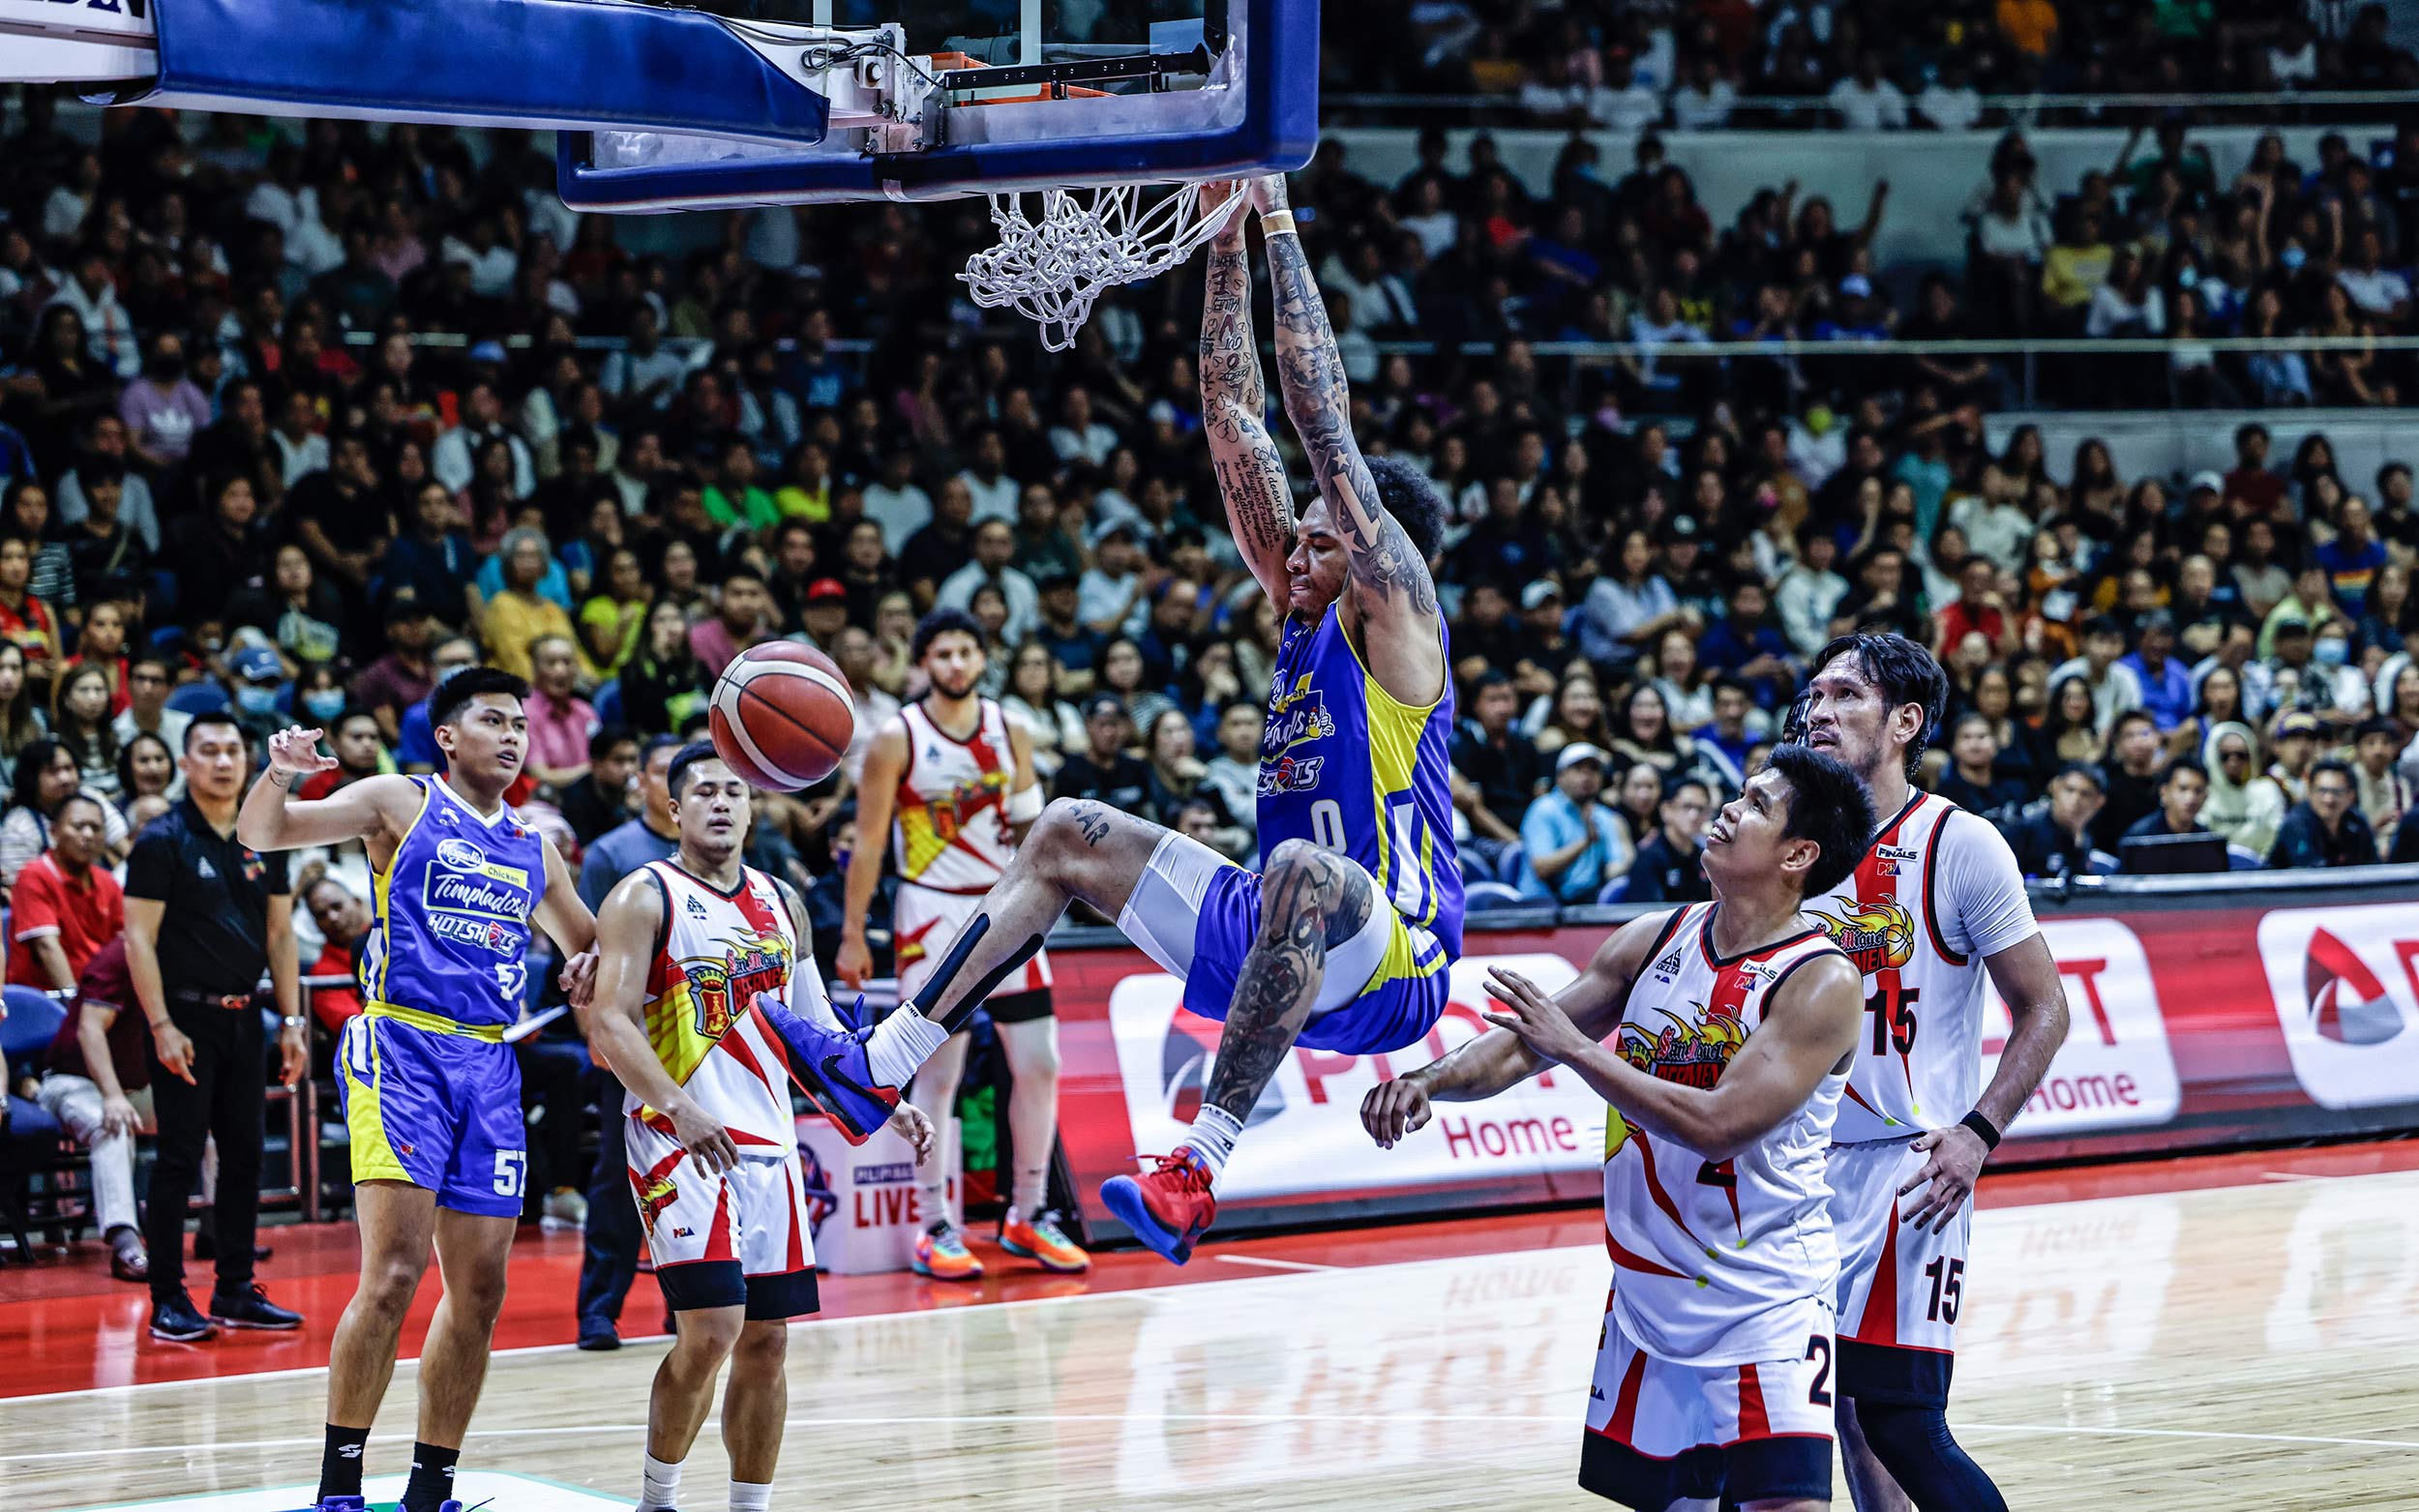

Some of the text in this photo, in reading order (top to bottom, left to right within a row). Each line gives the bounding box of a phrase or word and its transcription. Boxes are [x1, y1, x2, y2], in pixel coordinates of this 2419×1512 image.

[1252, 446, 1274, 475] God
[1268, 476, 1287, 514] doesn't
[1310, 799, 1347, 855] 0
[438, 841, 484, 867] Magnolia
[1877, 862, 1901, 876] PBA
[1878, 847, 1917, 860] FINALS
[488, 866, 520, 884] Chicken
[1840, 926, 1888, 950] Miguel
[1656, 963, 1680, 976] DELTA
[1865, 988, 1920, 1055] 15
[1657, 1025, 1687, 1061] San
[1441, 1115, 1578, 1159] Home
[855, 1188, 920, 1228] LIVE
[1925, 1255, 1963, 1325] 15
